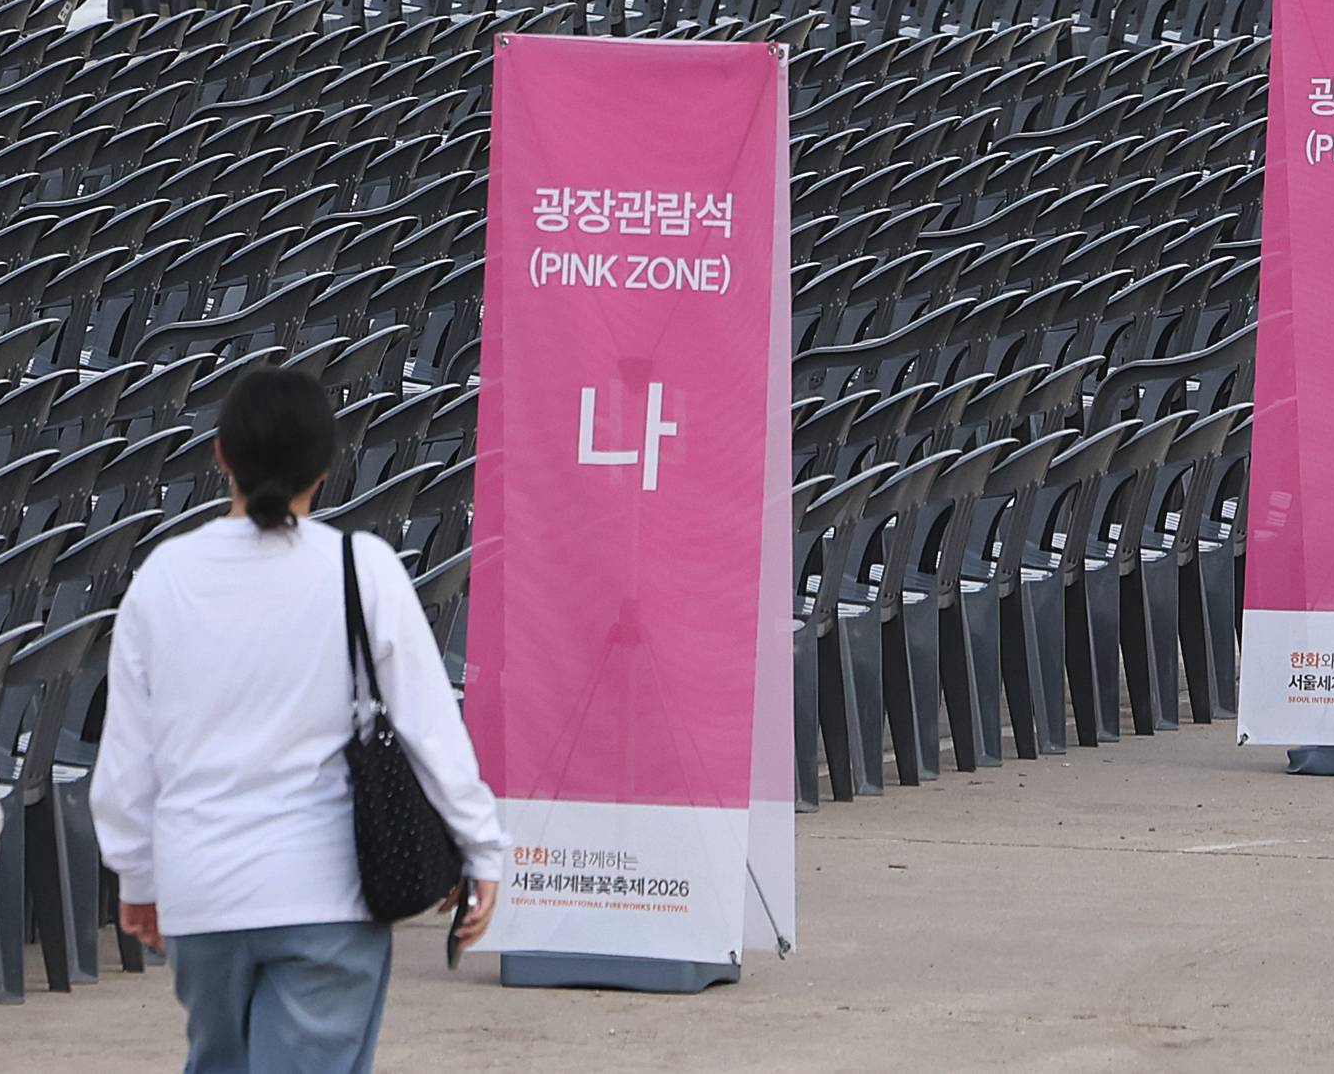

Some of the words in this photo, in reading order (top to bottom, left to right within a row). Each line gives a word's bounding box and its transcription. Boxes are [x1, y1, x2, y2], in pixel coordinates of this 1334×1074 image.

[532, 187, 733, 238] 광장관람석
[530, 247, 619, 288] (PINK
[624, 254, 731, 294] ZONE)
[578, 382, 677, 491] 나
[1288, 695, 1310, 703] SEOUL
[514, 846, 566, 867] 한화와
[571, 849, 639, 871] 함께하는
[646, 878, 690, 898] 2026
